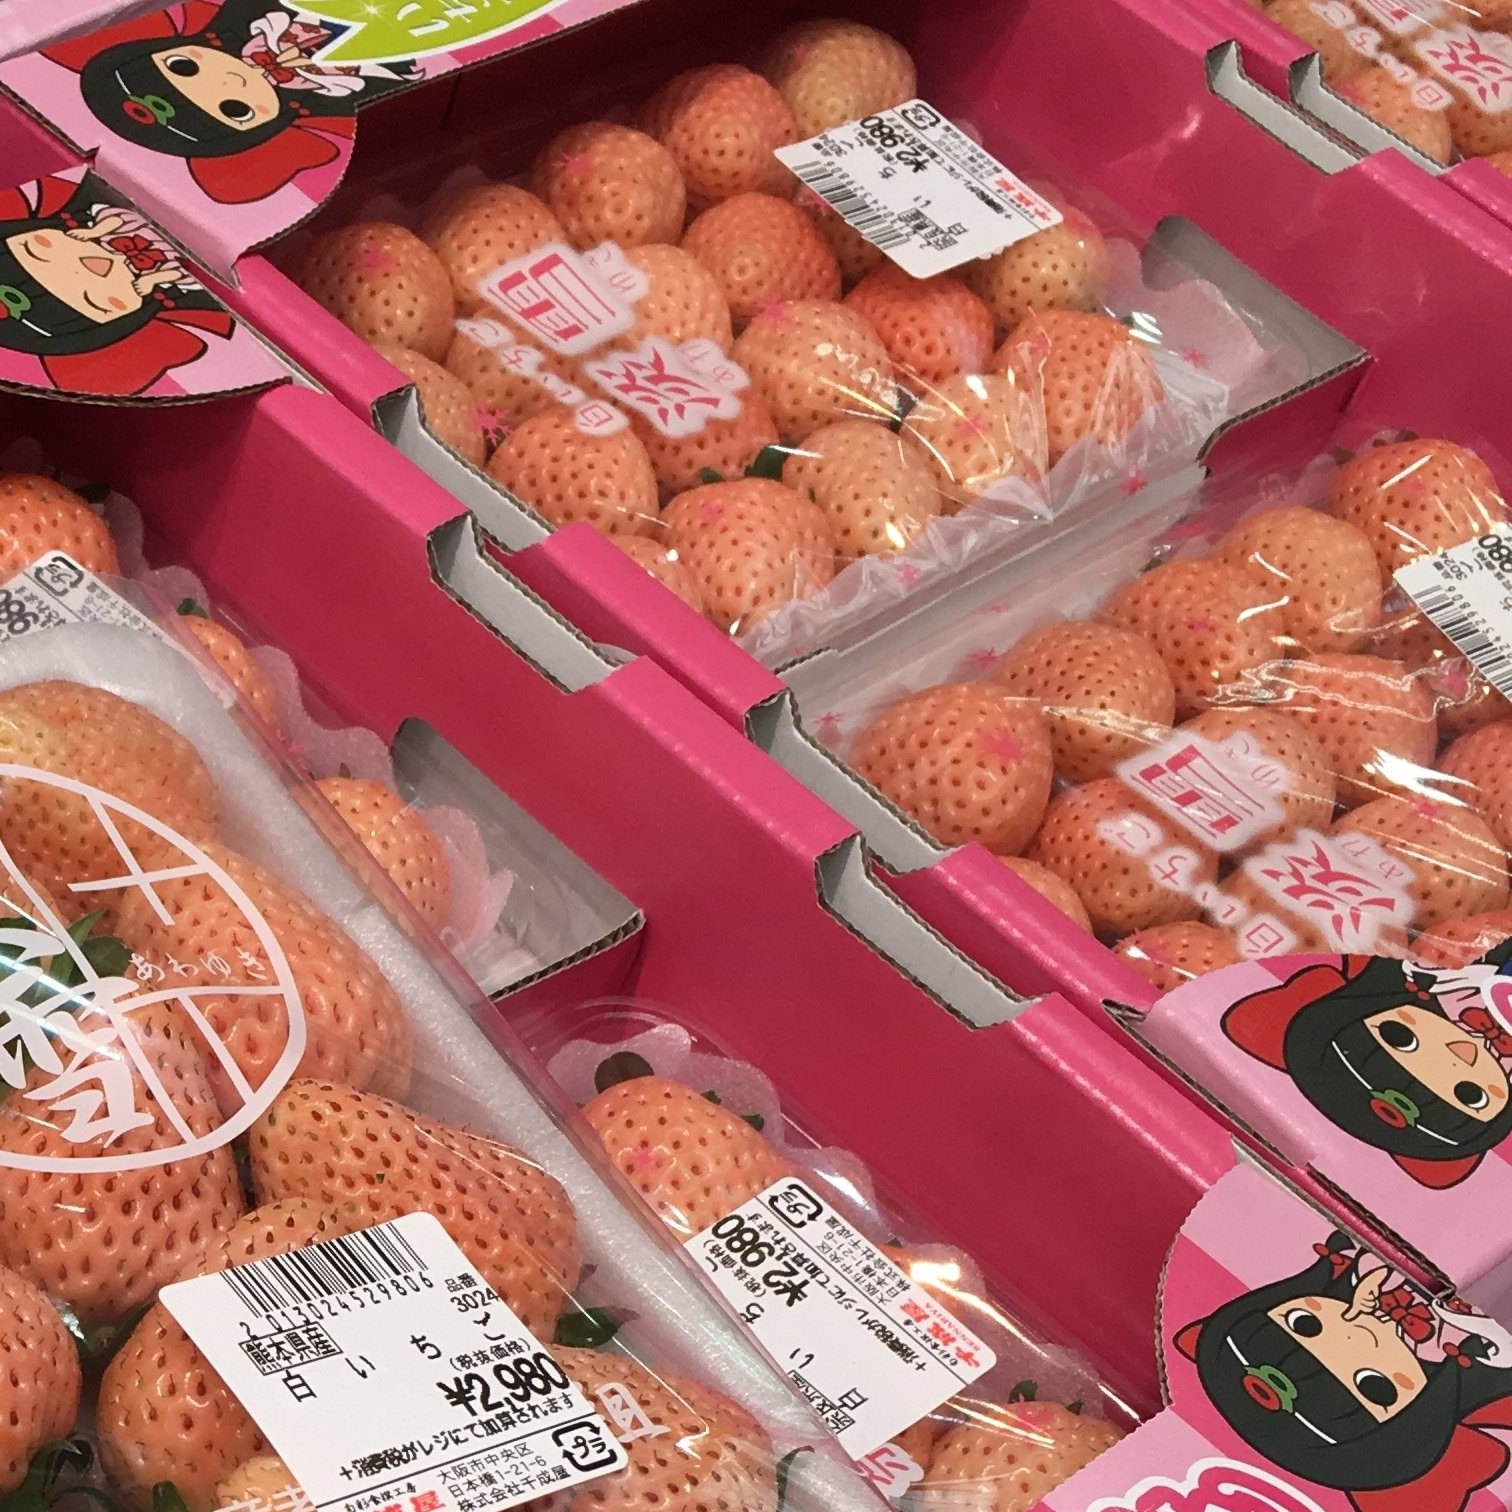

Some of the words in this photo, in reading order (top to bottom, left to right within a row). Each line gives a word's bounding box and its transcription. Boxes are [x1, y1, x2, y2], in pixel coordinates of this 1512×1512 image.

[495, 252, 723, 430] 淡雪
[1132, 745, 1396, 941] 淡雪
[1112, 819, 1284, 953] 白いちご
[441, 1272, 479, 1293] 品番
[707, 1206, 818, 1314] ¥2,980
[814, 1237, 891, 1309] 大阪市中央区
[821, 1228, 900, 1301] 日本橋1-21-6
[823, 1214, 913, 1294] 株式会社千成屋
[237, 1265, 435, 1345] 2013024529806
[449, 1285, 502, 1314] 3024
[242, 1322, 338, 1375] 熊本県産
[435, 1347, 578, 1428] ¥2,980
[434, 1440, 534, 1485] 大阪市中央区
[445, 1453, 549, 1499] 日本橋1-21-6
